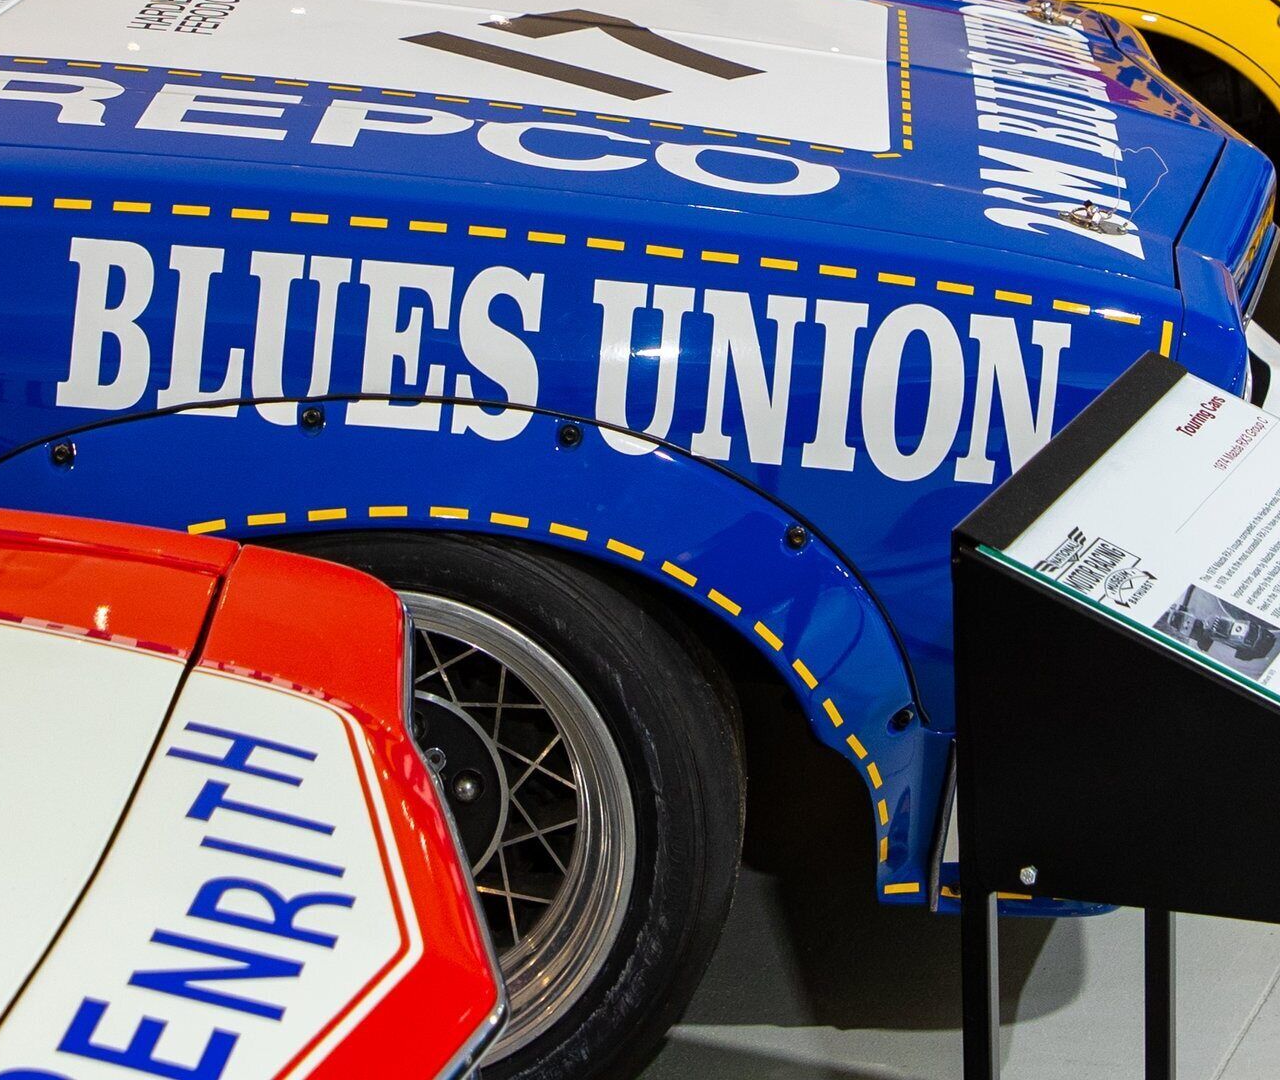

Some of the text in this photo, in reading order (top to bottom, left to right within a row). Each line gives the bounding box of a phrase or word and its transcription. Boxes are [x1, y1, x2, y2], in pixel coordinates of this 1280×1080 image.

[398, 9, 768, 100] 17
[55, 236, 1072, 485] BLUES UNION
[1175, 393, 1226, 439] Touring Cars
[1212, 415, 1269, 471] 1974 Mazda RX3 Group C
[1047, 539, 1080, 567] NATIONAL
[1062, 541, 1127, 595] MOTOR RACING
[1102, 567, 1133, 593] MUSEUM
[1126, 579, 1155, 605] BATHURST
